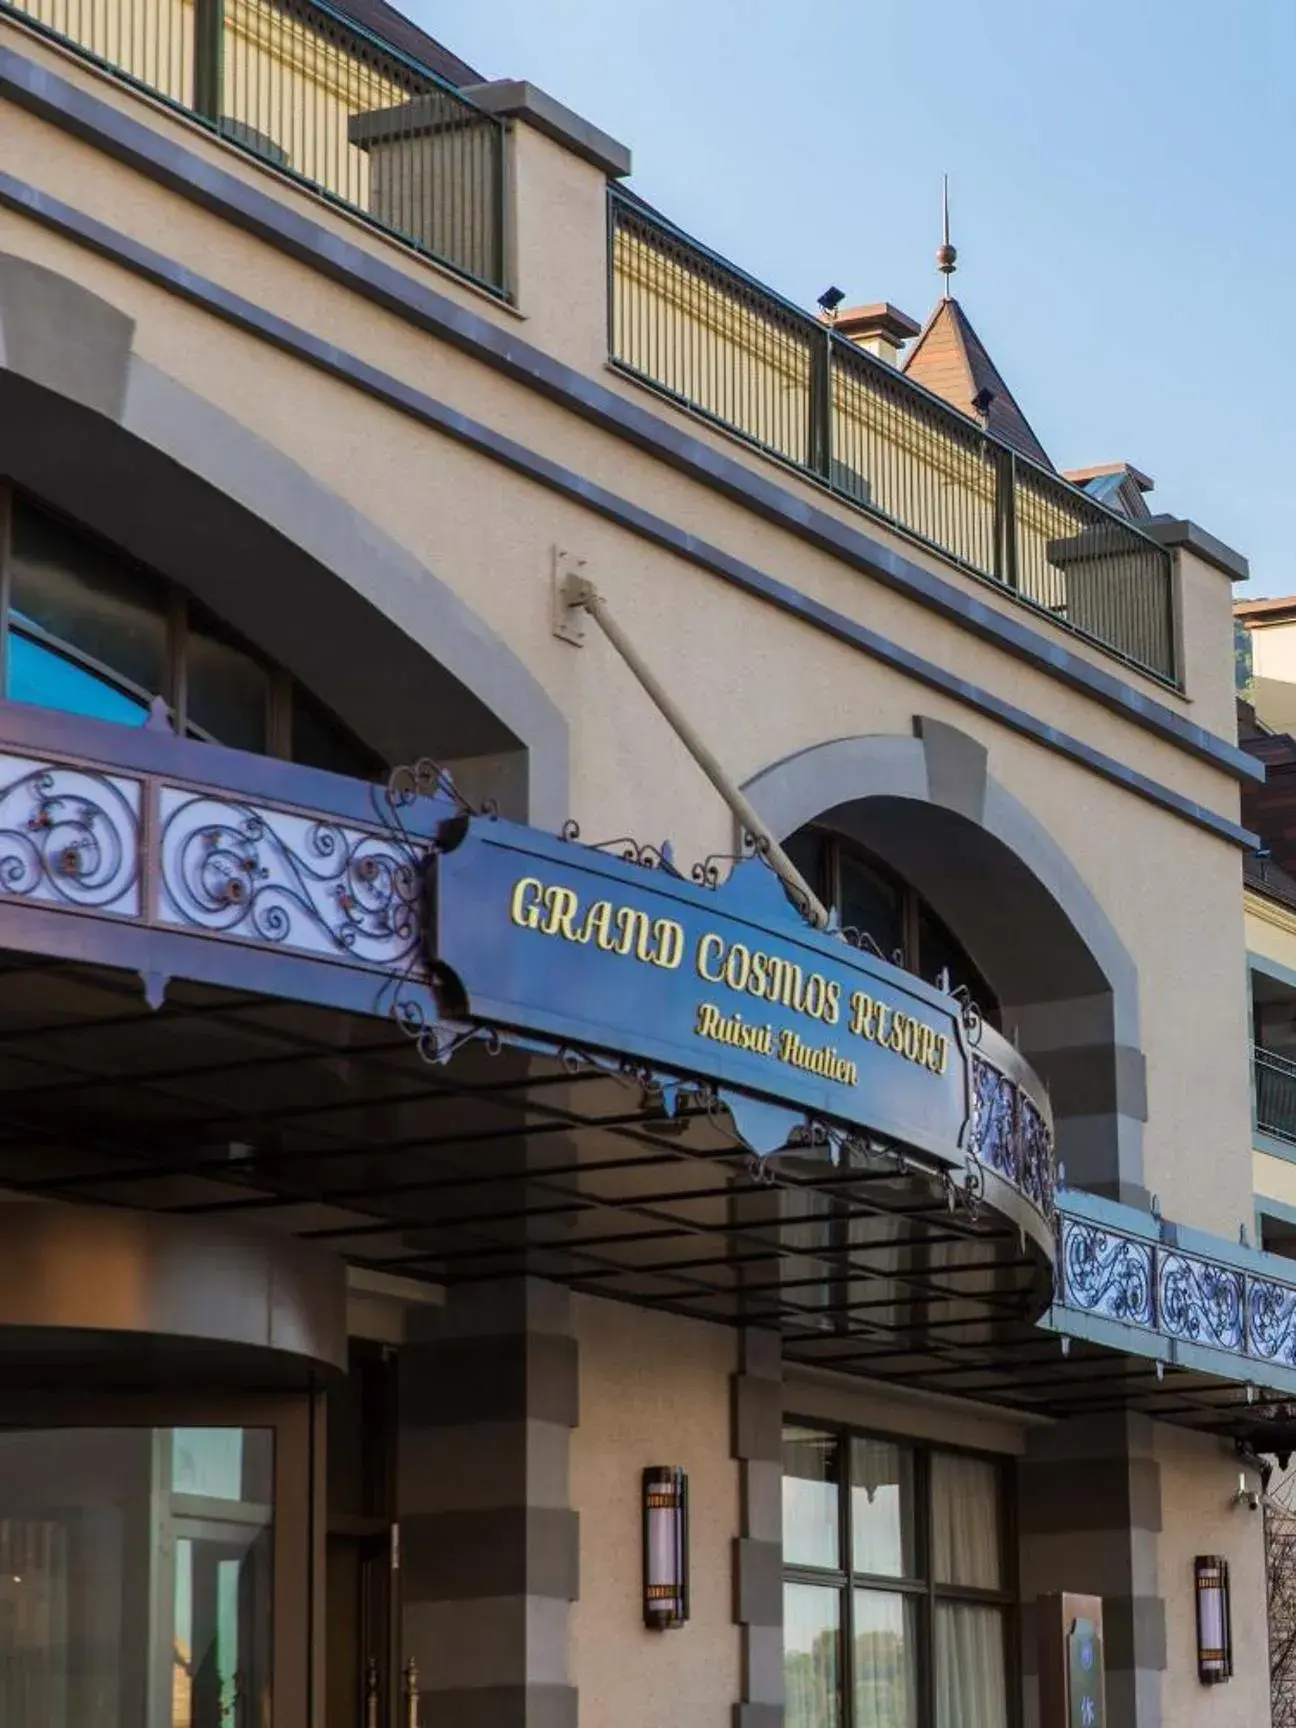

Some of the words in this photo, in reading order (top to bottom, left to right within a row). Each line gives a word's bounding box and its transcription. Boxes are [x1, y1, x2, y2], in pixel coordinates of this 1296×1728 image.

[511, 876, 685, 970] GRAND
[697, 932, 841, 1025] COSMOS
[849, 990, 949, 1075] RESORT
